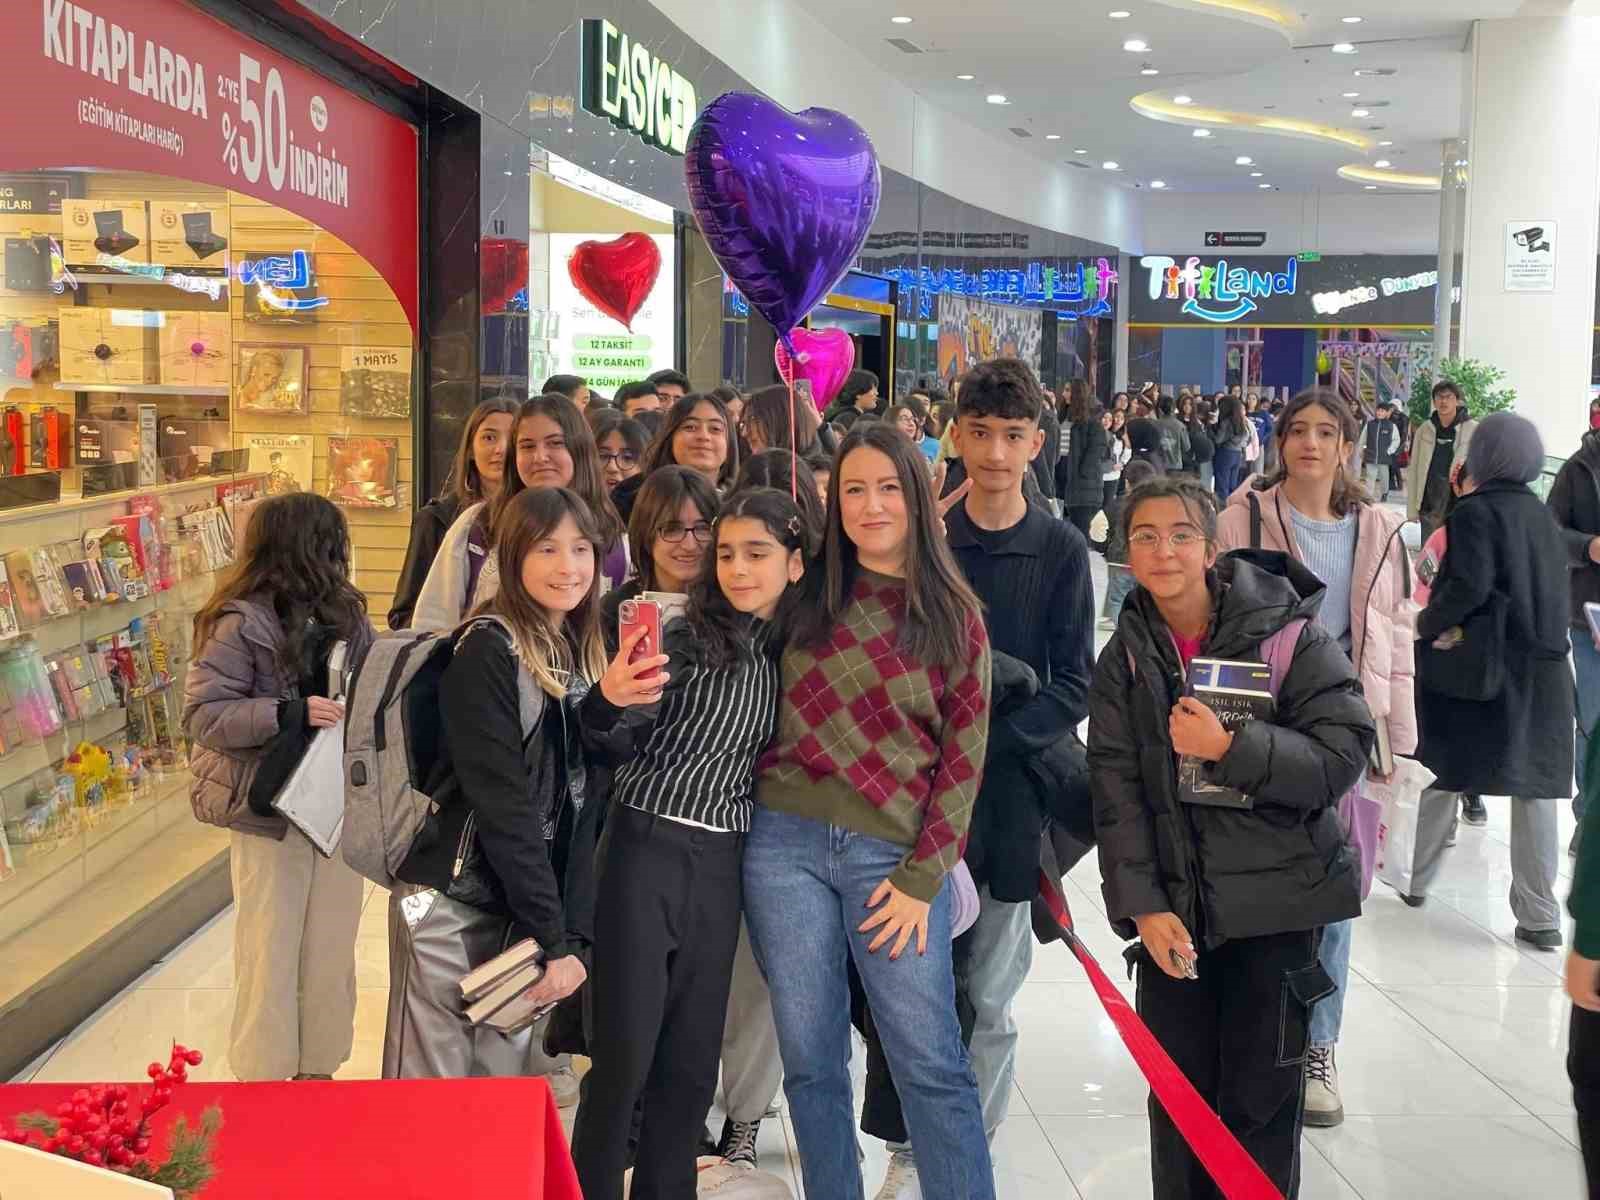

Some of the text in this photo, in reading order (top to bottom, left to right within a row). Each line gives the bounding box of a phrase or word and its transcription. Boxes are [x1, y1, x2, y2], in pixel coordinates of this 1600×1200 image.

[289, 129, 349, 208] İNDİRİM
[590, 339, 633, 350] 12 TAKSİT
[579, 358, 588, 367] 12
[590, 358, 601, 367] AY
[597, 376, 616, 387] GÜN
